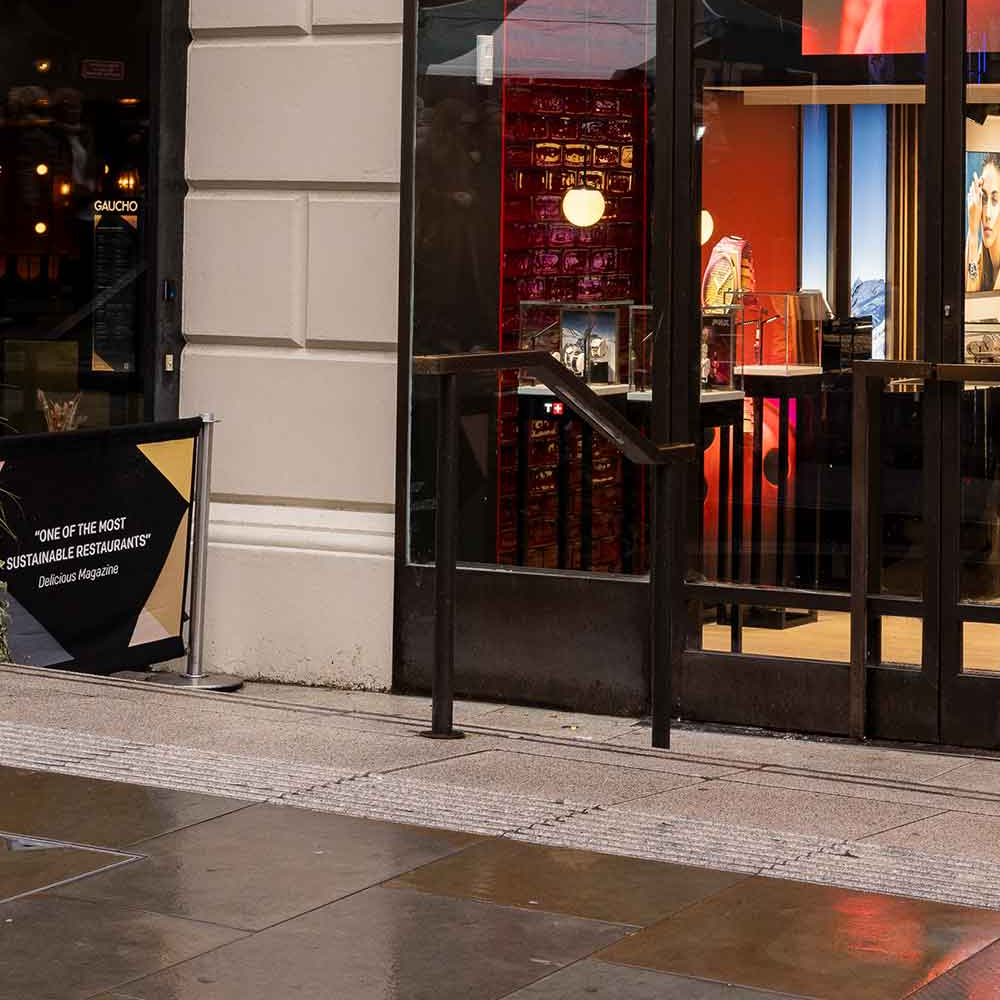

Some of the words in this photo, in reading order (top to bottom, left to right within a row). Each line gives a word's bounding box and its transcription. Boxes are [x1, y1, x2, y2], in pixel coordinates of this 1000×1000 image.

[94, 200, 138, 212] GAUCHO
[62, 524, 76, 539] OF
[77, 521, 97, 536] THE
[98, 516, 127, 533] MOST
[6, 546, 75, 571] SUSTAINABLE
[38, 572, 77, 589] Delicious
[78, 564, 119, 581] Magazine
